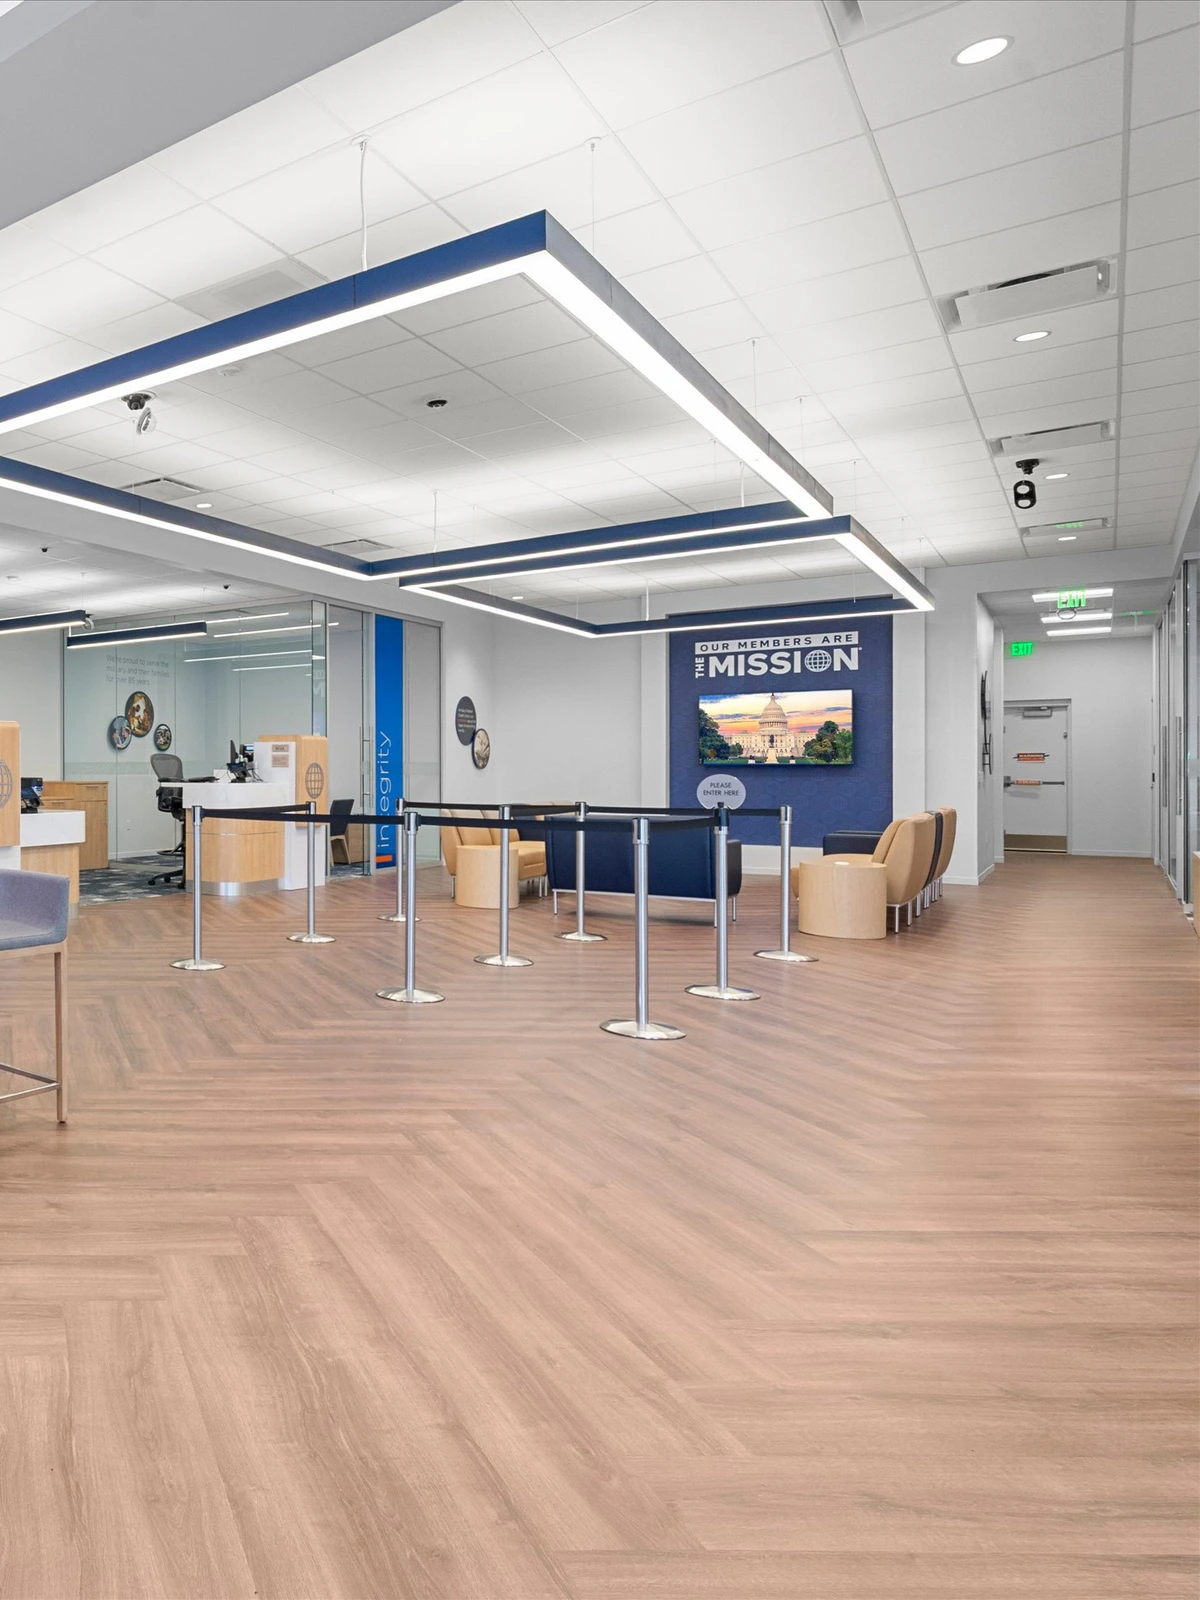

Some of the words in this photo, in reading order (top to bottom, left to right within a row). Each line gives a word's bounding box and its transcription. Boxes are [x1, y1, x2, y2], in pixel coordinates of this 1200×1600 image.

[1057, 588, 1086, 608] EXIT
[700, 642, 730, 652] OUR
[738, 636, 812, 649] MEMBERS
[821, 633, 853, 644] ARE
[1011, 642, 1033, 656] EXIT
[695, 656, 705, 678] THE
[708, 647, 859, 678] MISSION
[377, 731, 392, 848] inegrity
